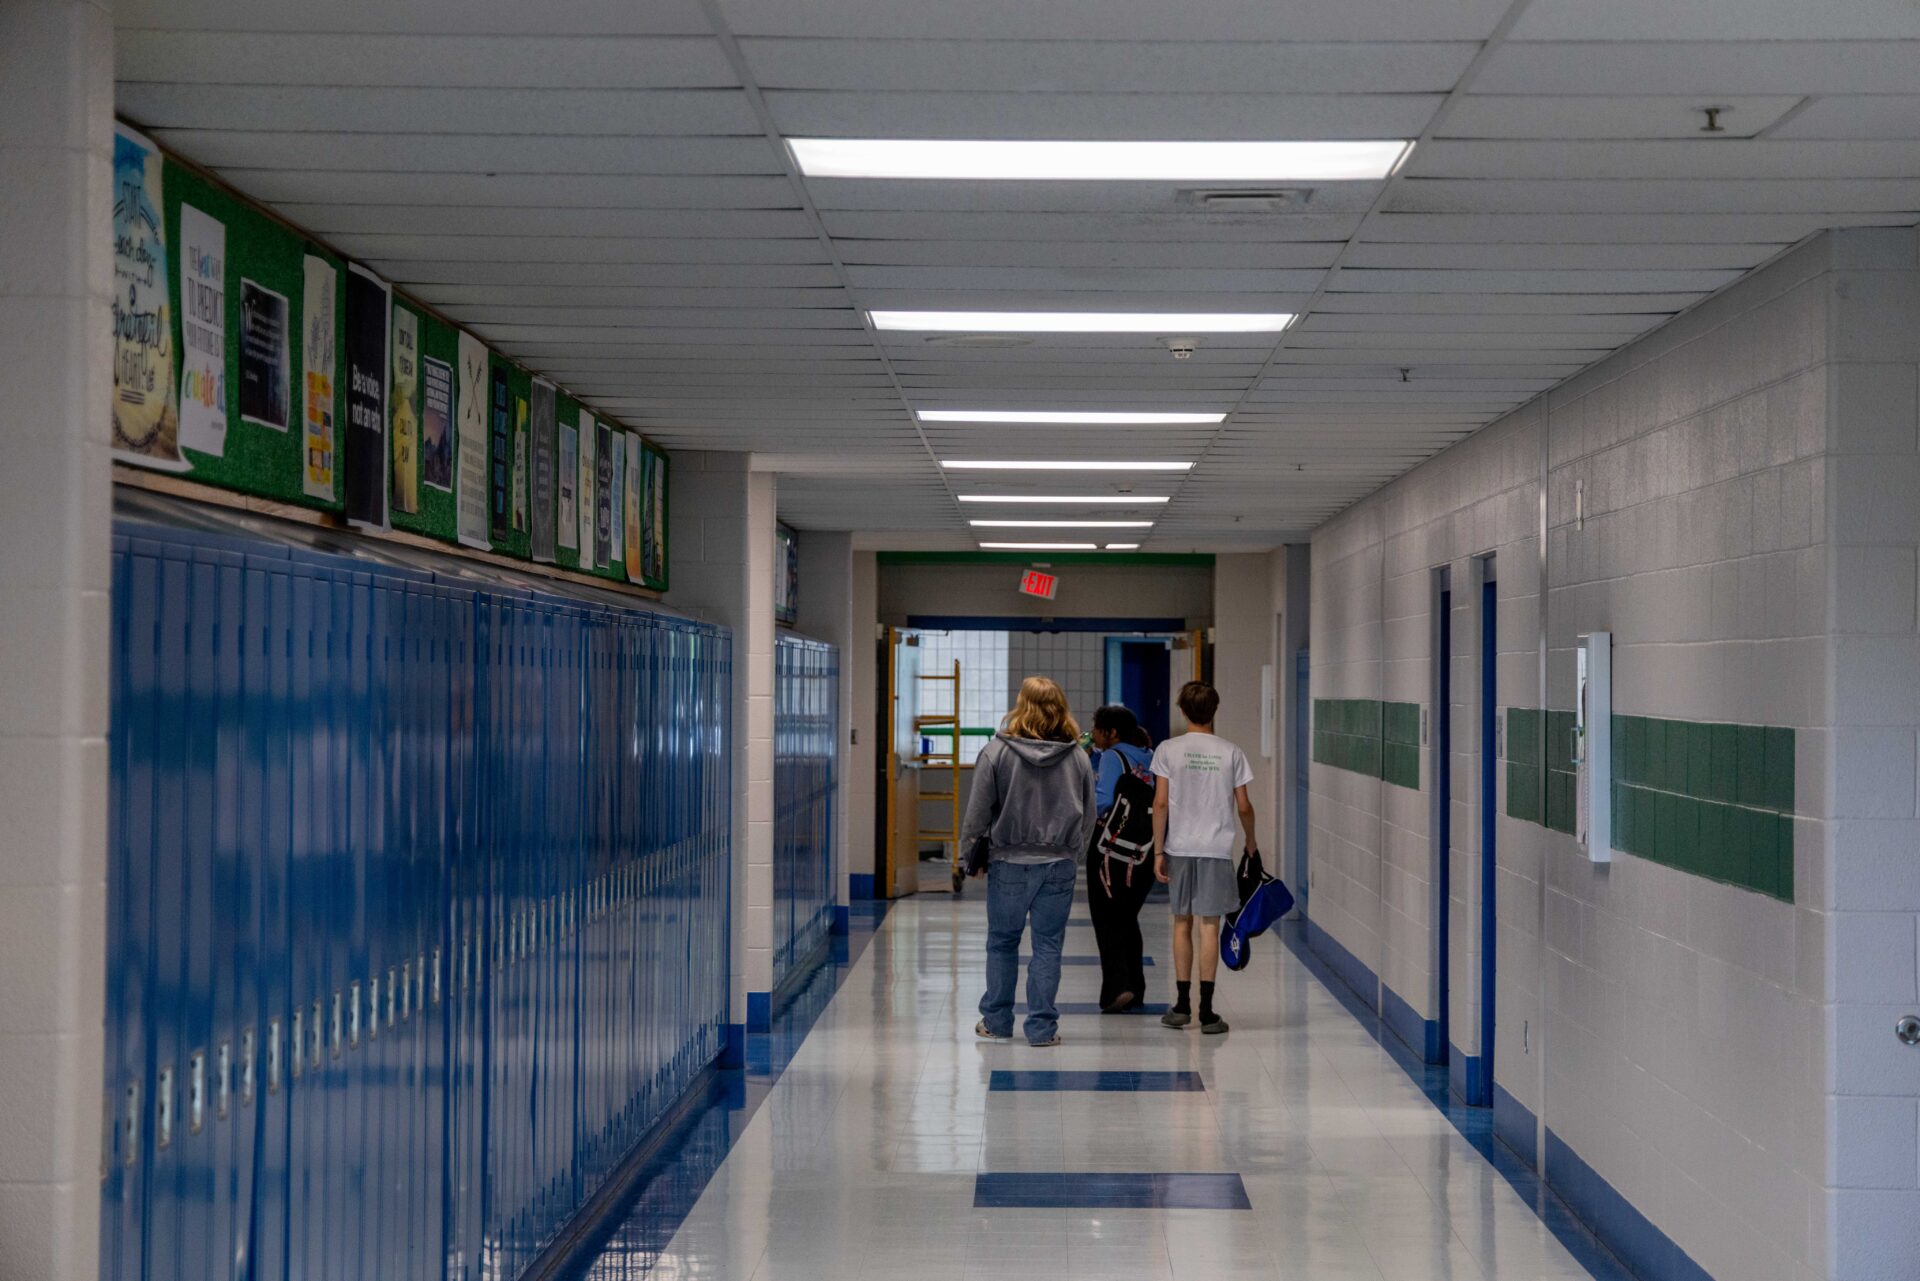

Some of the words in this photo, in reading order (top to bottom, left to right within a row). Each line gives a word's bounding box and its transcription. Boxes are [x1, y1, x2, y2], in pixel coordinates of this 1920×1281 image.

[197, 282, 225, 329] PREDICT
[185, 362, 217, 409] create
[353, 364, 362, 393] Be
[361, 374, 366, 395] a
[352, 401, 364, 427] not
[364, 407, 371, 429] an
[1026, 571, 1054, 597] EXIT
